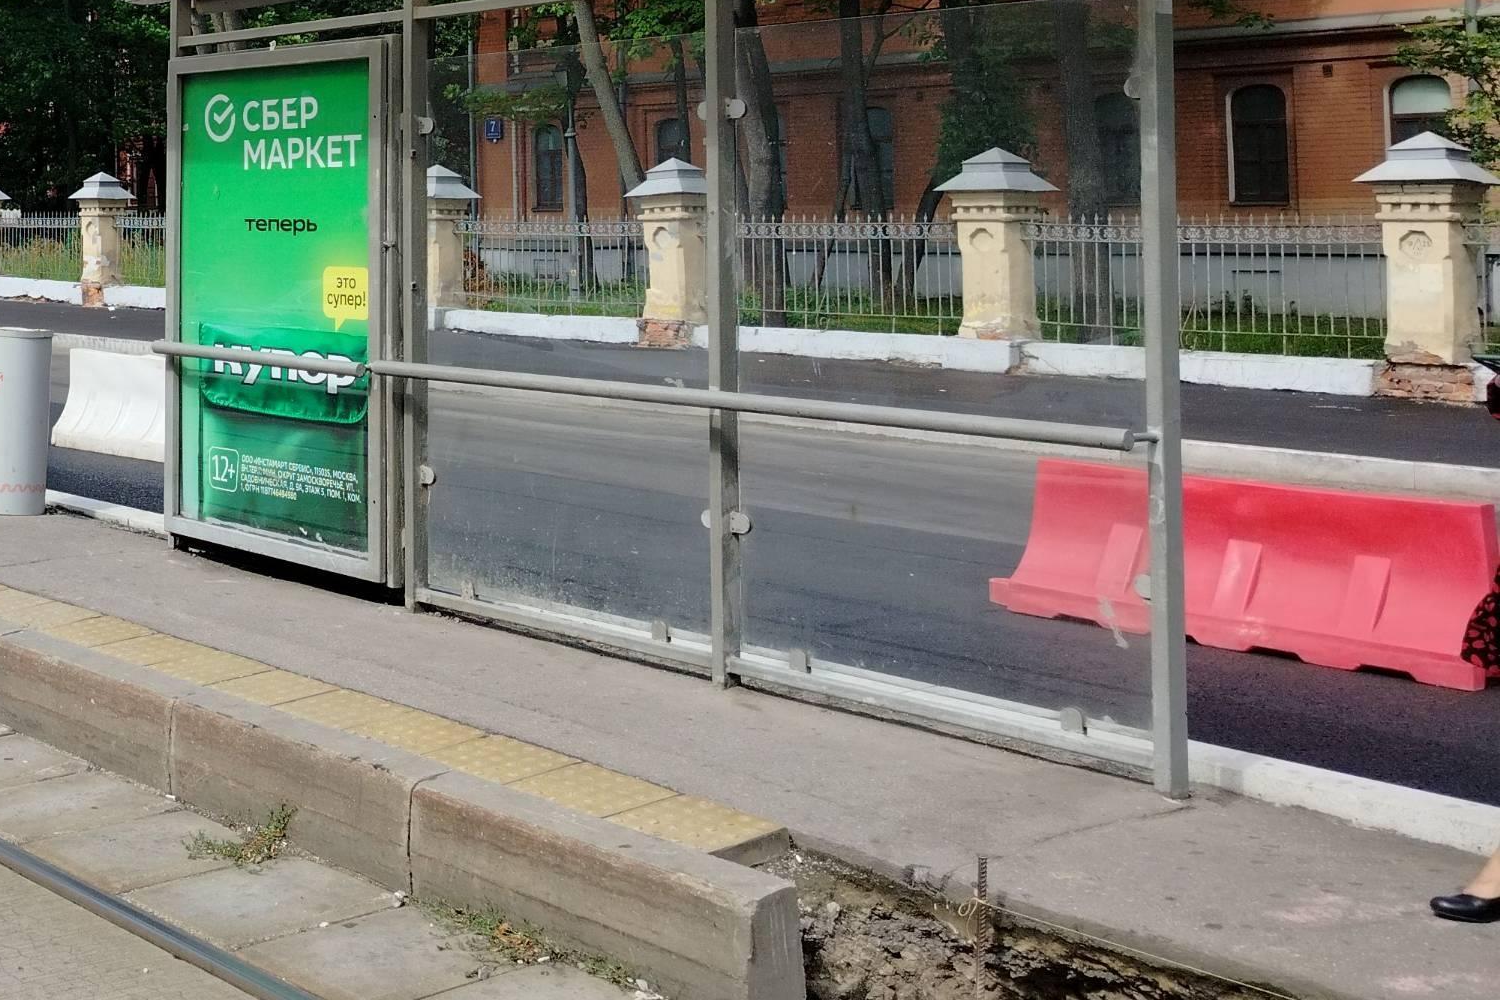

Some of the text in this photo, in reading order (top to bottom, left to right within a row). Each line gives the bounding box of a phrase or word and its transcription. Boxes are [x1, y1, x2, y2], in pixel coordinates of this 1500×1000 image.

[243, 96, 318, 132] СБЕР
[490, 121, 496, 132] 7
[243, 134, 362, 170] МАРКЕТ
[244, 218, 318, 236] теперь
[336, 277, 356, 289] это
[327, 291, 367, 309] супер!
[211, 454, 236, 483] 12+
[332, 469, 359, 484] МОСКВА,
[304, 484, 320, 495] ЭТАЖ
